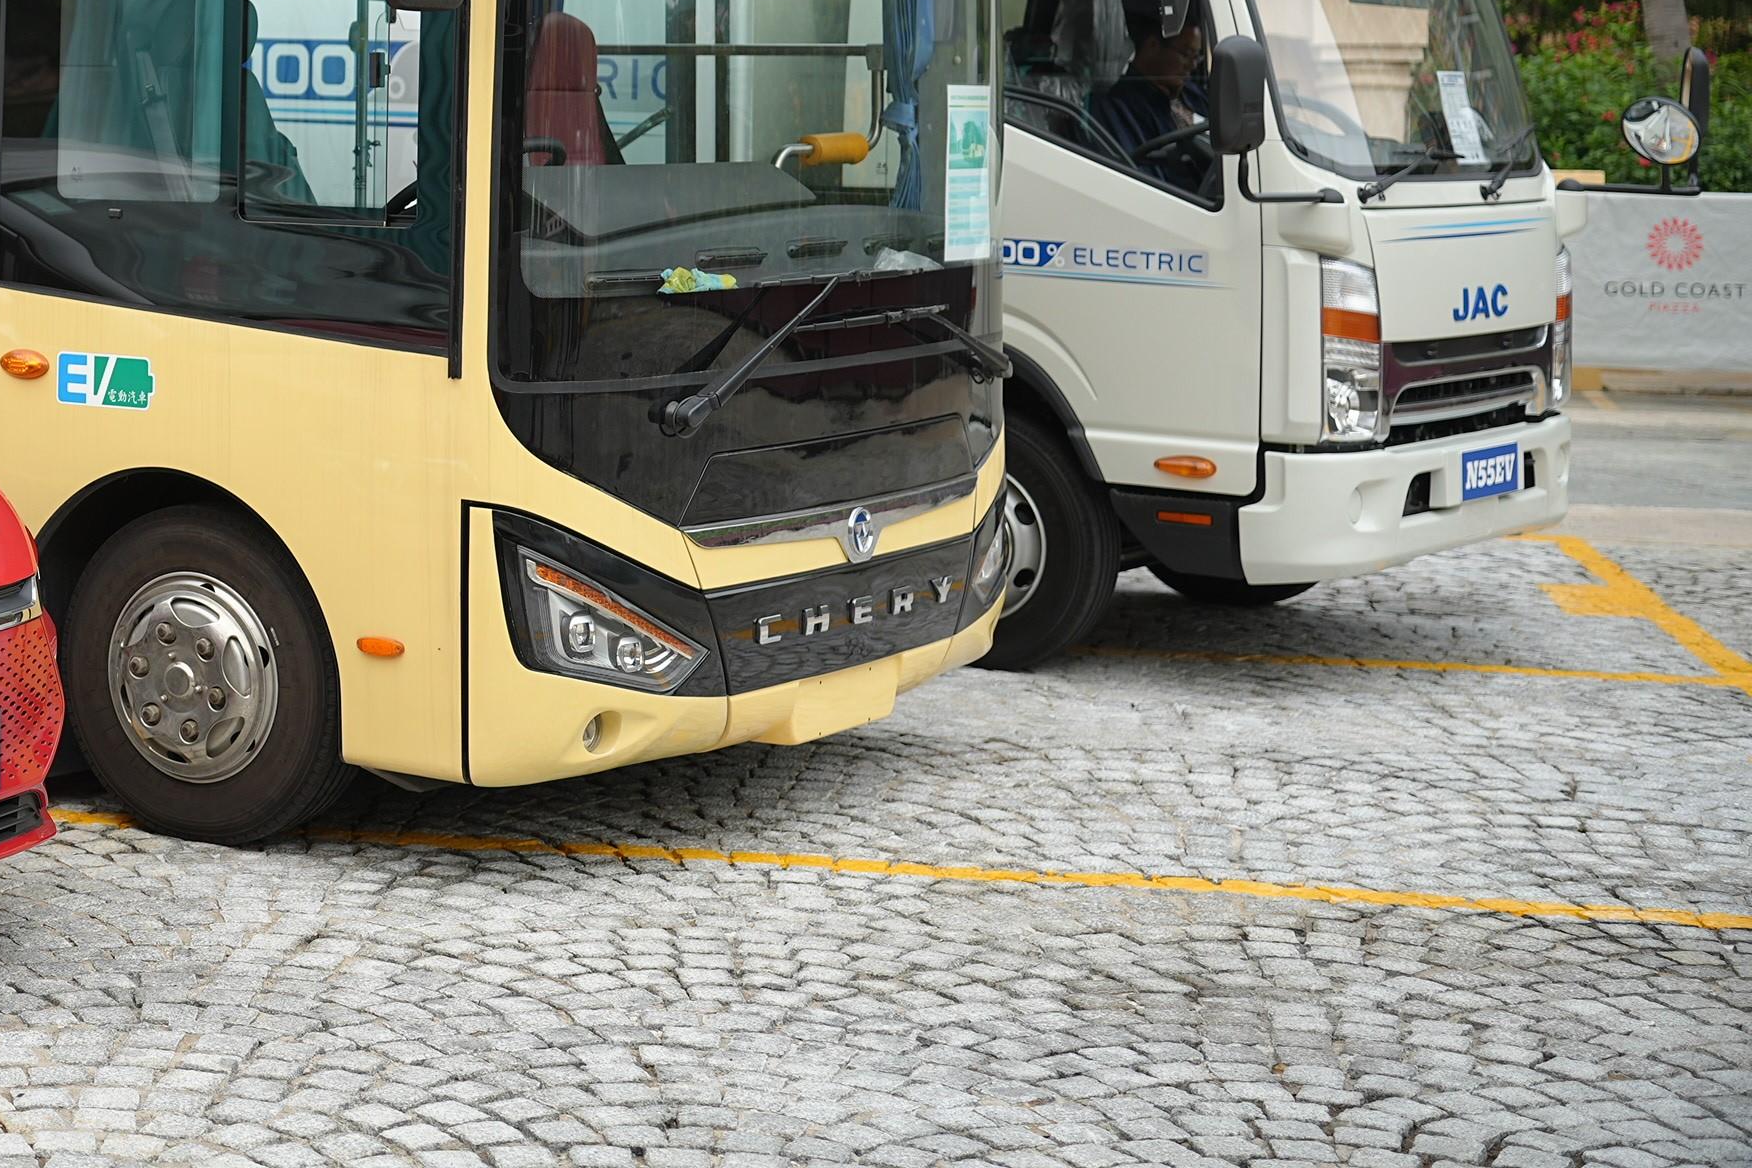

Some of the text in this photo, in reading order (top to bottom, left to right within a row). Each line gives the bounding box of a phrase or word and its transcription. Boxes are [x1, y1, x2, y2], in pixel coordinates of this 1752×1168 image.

[1073, 247, 1204, 274] ELECTRIC
[1453, 283, 1508, 322] JAC
[1605, 280, 1746, 300] GOLD COAST
[57, 351, 118, 406] EV
[107, 388, 148, 405] 電動汽車
[1465, 452, 1517, 491] N55EV
[753, 575, 953, 646] CHERY
